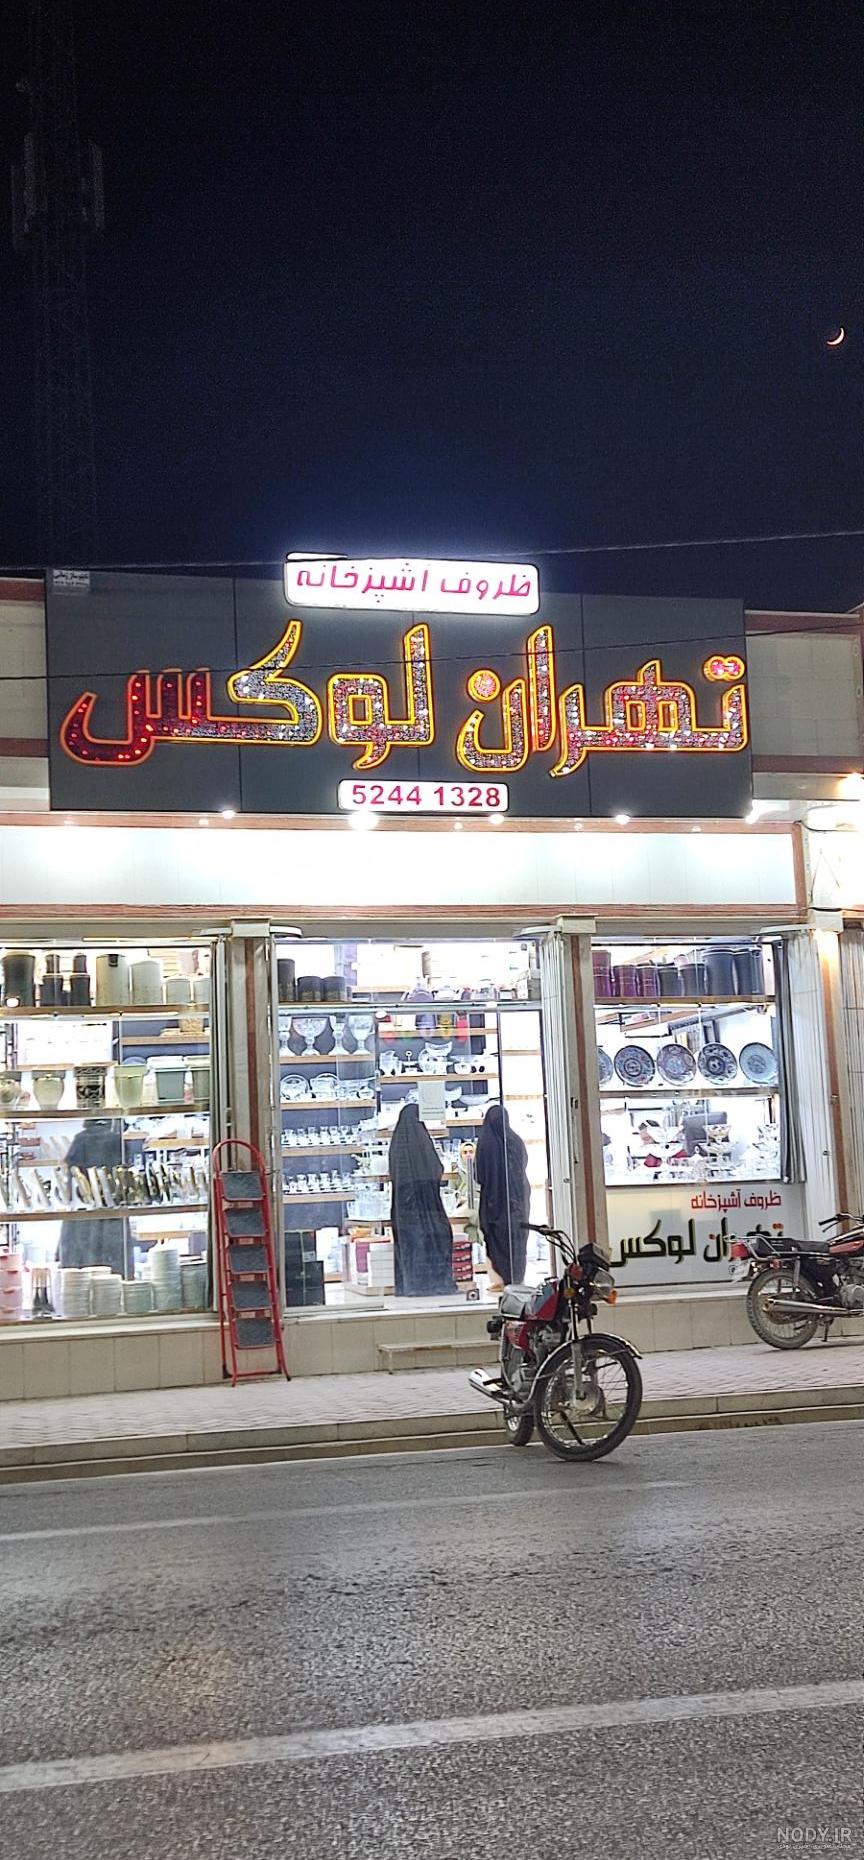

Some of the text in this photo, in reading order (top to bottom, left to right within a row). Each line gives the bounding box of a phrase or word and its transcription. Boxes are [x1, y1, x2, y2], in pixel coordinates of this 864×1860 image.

[441, 571, 531, 600] ظروف
[60, 619, 749, 777] تهران لوکس
[352, 784, 501, 807] 5244 1328
[691, 1188, 782, 1213] ظروف آشپزخانه
[609, 1217, 784, 1268] تان لوکس
